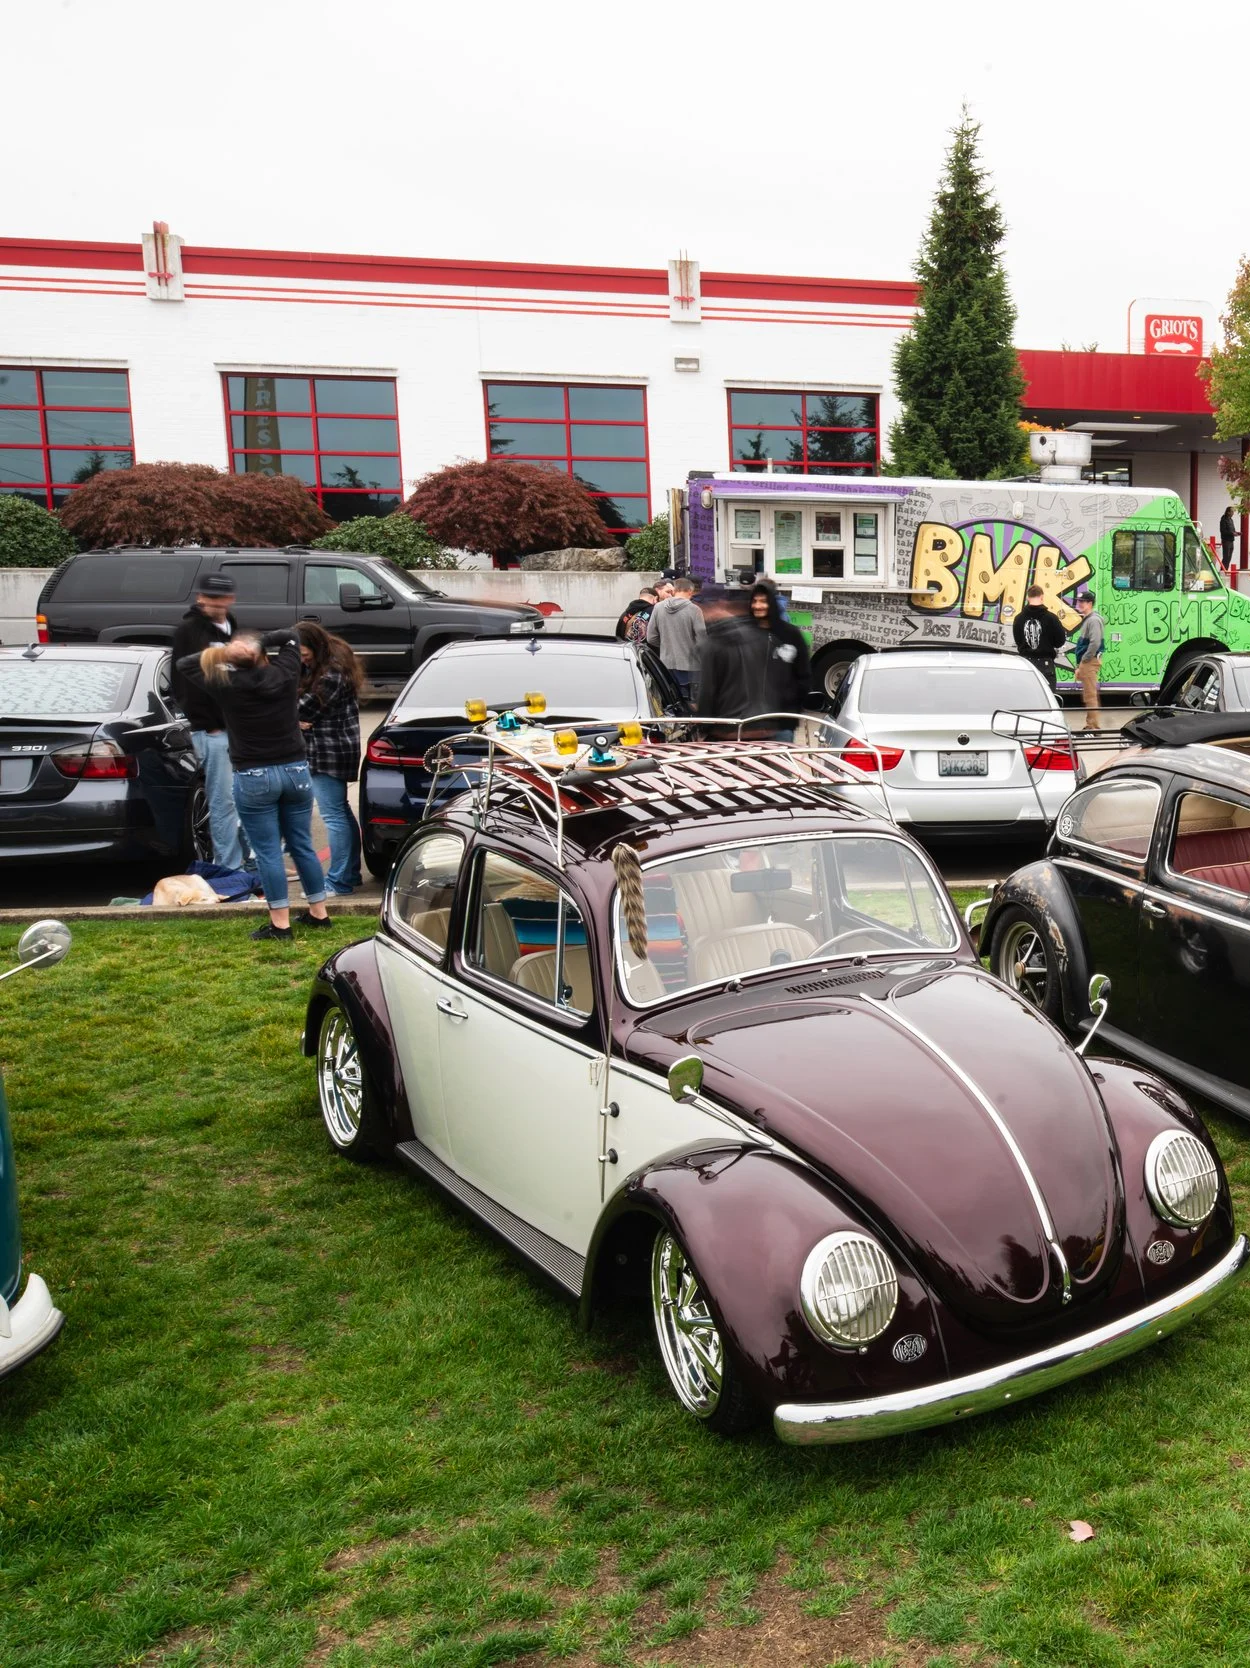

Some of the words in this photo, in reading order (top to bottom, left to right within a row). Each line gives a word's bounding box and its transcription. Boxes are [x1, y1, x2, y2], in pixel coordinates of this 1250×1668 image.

[897, 516, 919, 528] Frie
[911, 521, 1094, 633] BMK
[828, 605, 877, 621] Burgers
[1098, 602, 1139, 625] BMK
[1145, 600, 1228, 644] BMK
[814, 624, 845, 636] Fries
[861, 621, 911, 637] Burgers
[922, 619, 951, 638] Boss
[956, 621, 1007, 645] Mama's
[1098, 657, 1126, 682] MK
